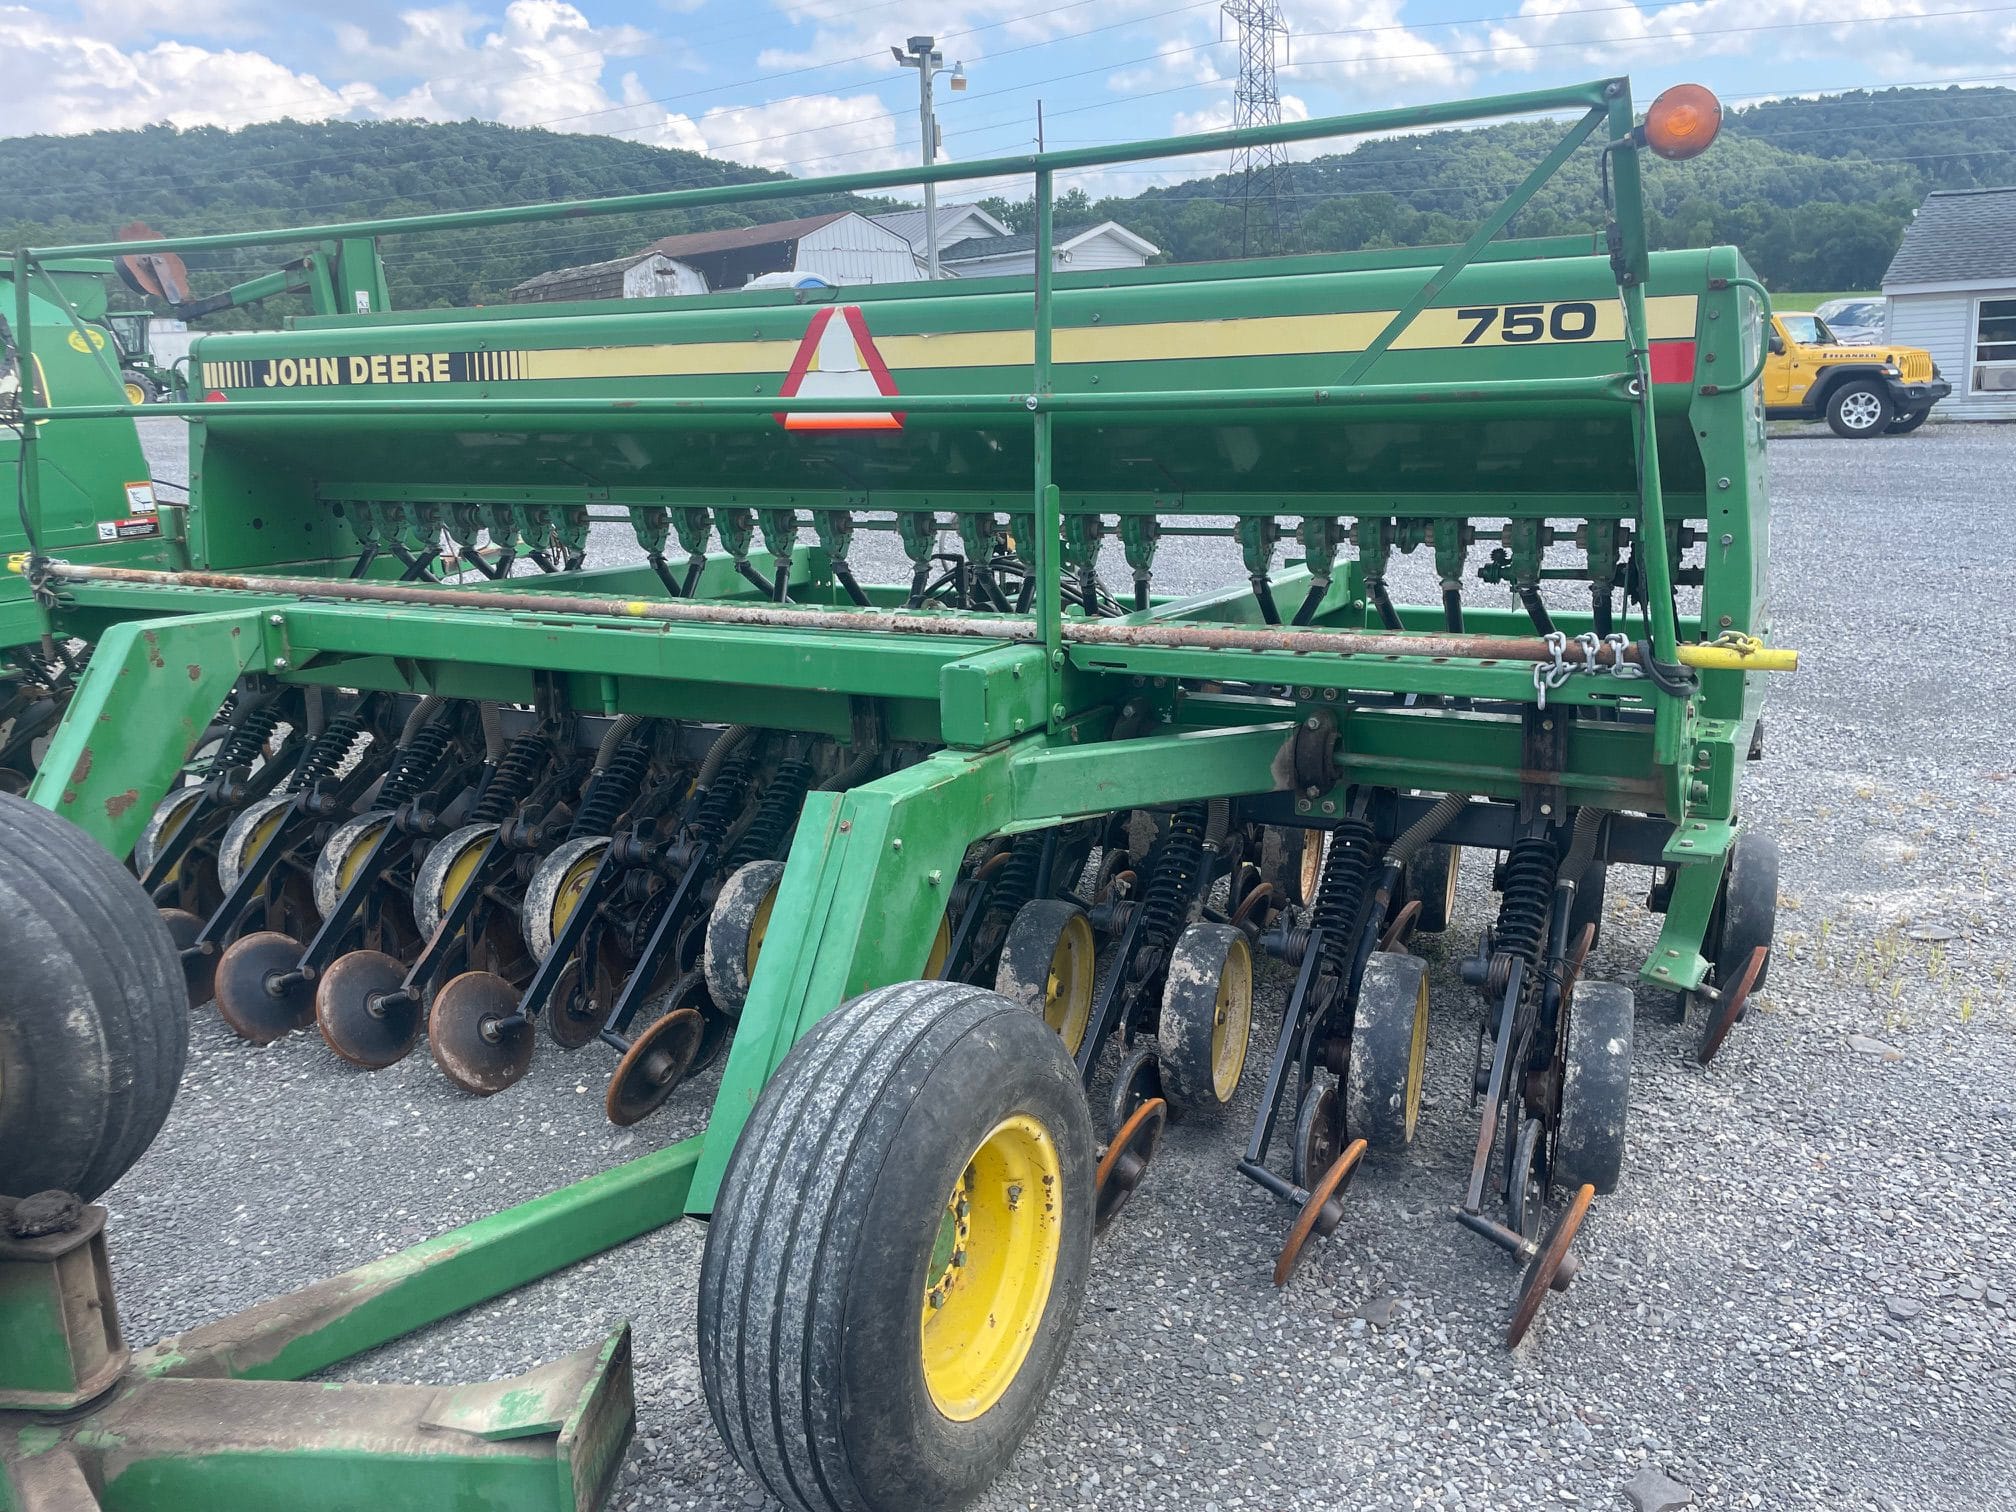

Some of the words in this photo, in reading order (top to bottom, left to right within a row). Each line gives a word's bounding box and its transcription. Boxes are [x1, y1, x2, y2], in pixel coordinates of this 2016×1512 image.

[1457, 302, 1597, 345] 750
[263, 357, 340, 387] JOHN
[349, 352, 450, 384] DEERE
